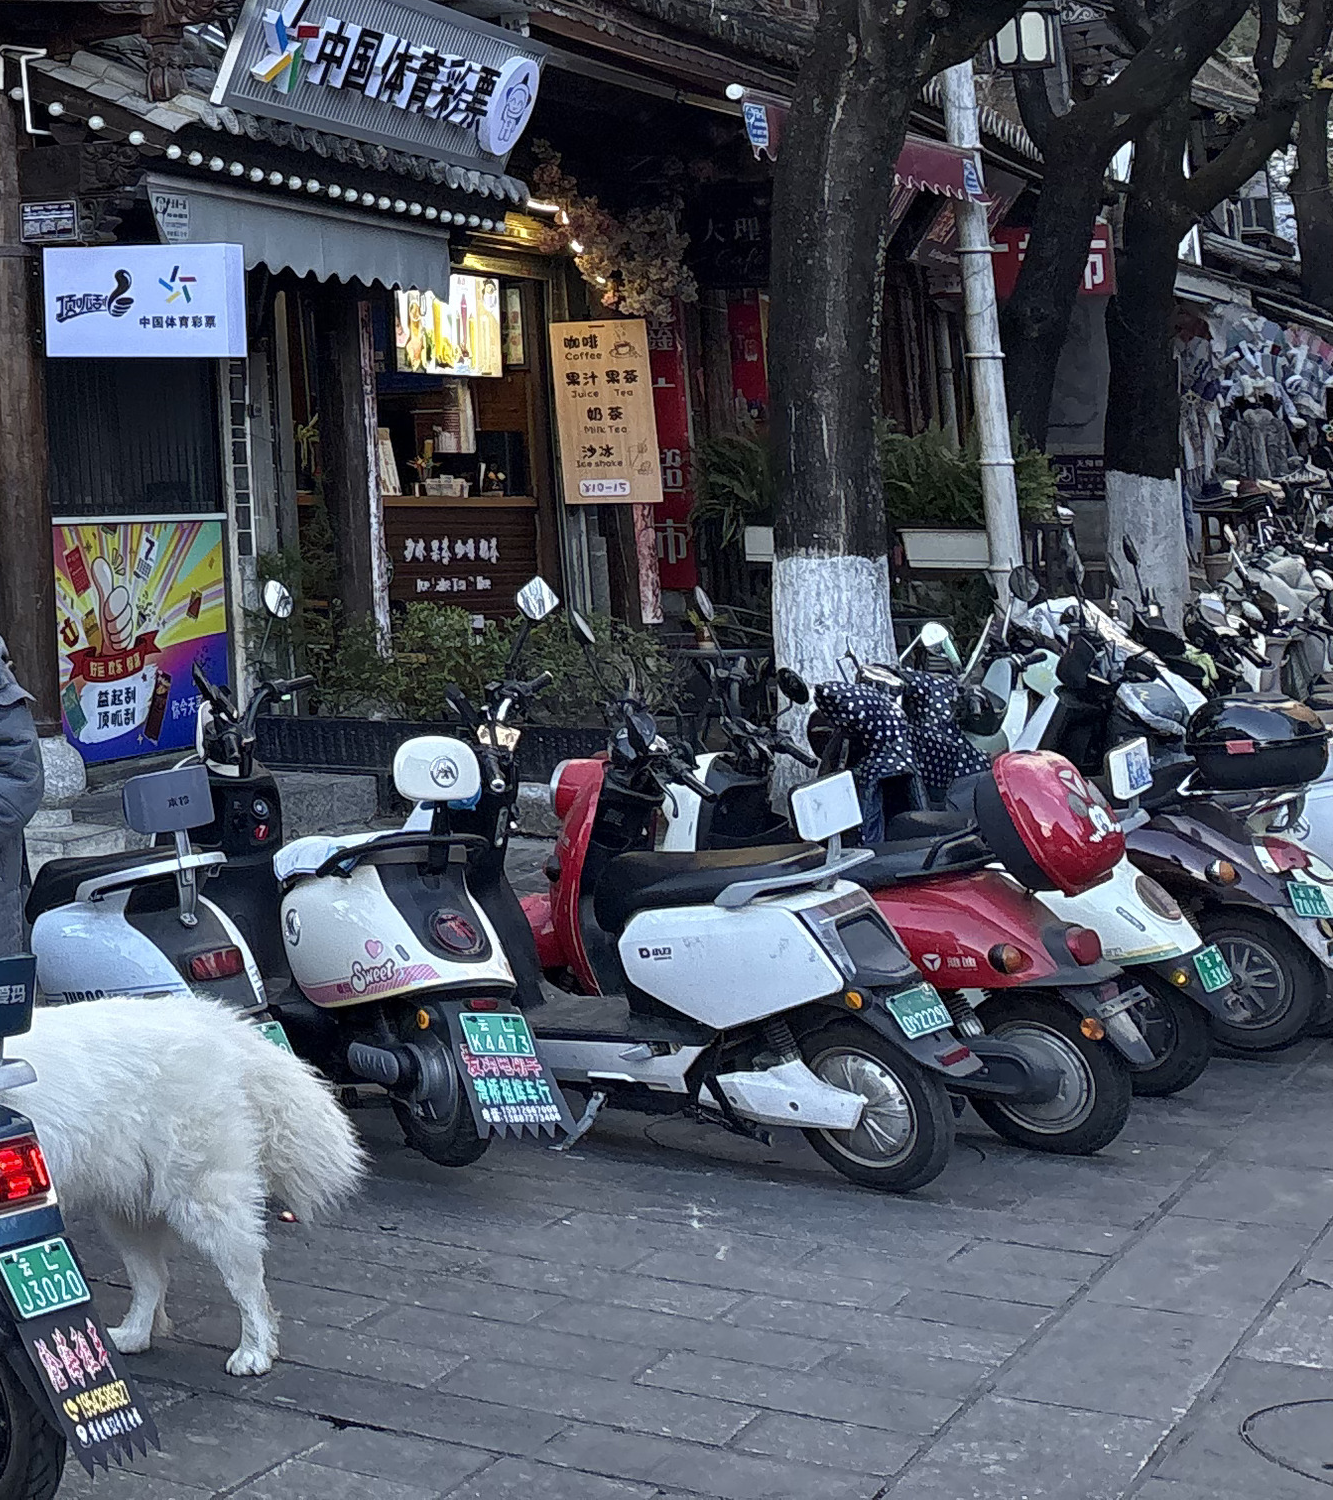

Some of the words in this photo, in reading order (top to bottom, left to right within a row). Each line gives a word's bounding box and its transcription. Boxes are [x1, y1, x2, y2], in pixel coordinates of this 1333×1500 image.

[303, 16, 501, 131] 中国体育彩票
[139, 315, 217, 329] 中国体育彩票
[563, 333, 599, 350] 咖啡
[564, 351, 603, 361] Coffee
[565, 371, 599, 387] 果汁
[604, 369, 639, 385] 果茶
[571, 390, 600, 399] Juice
[613, 388, 634, 397] Tea
[586, 405, 624, 422] 奶茶
[607, 425, 628, 434] Tea
[580, 444, 615, 460] 沙冰
[576, 460, 593, 469] Ice
[96, 686, 137, 709] 益起刮
[96, 708, 136, 732] 顶呱刮
[351, 958, 396, 994] Sweet
[470, 1033, 531, 1053] K4473
[21, 1269, 84, 1312] J3020
